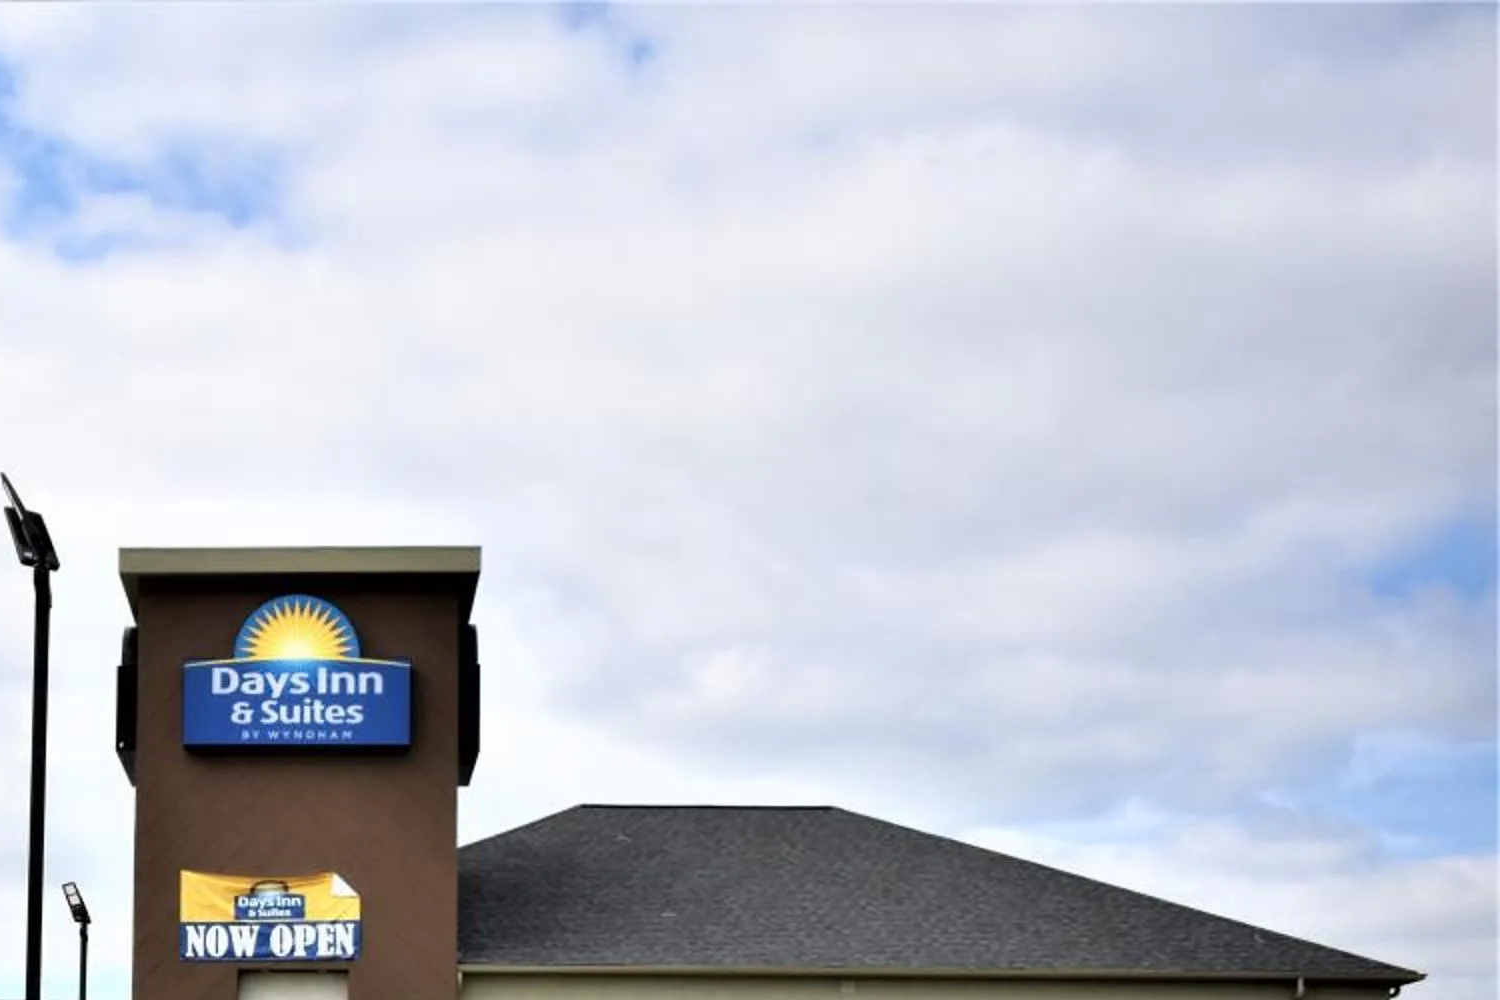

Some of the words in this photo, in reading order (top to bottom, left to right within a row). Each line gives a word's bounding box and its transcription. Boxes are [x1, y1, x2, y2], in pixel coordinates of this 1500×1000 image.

[211, 666, 310, 698] Days
[317, 667, 383, 695] Inn
[231, 701, 254, 724] &
[260, 698, 364, 724] Suites
[241, 730, 260, 740] BY
[268, 730, 353, 740] WYNDHAM
[238, 896, 273, 908] Days
[274, 896, 301, 907] Inn
[185, 924, 260, 957] NOW
[269, 923, 356, 958] OPEN
